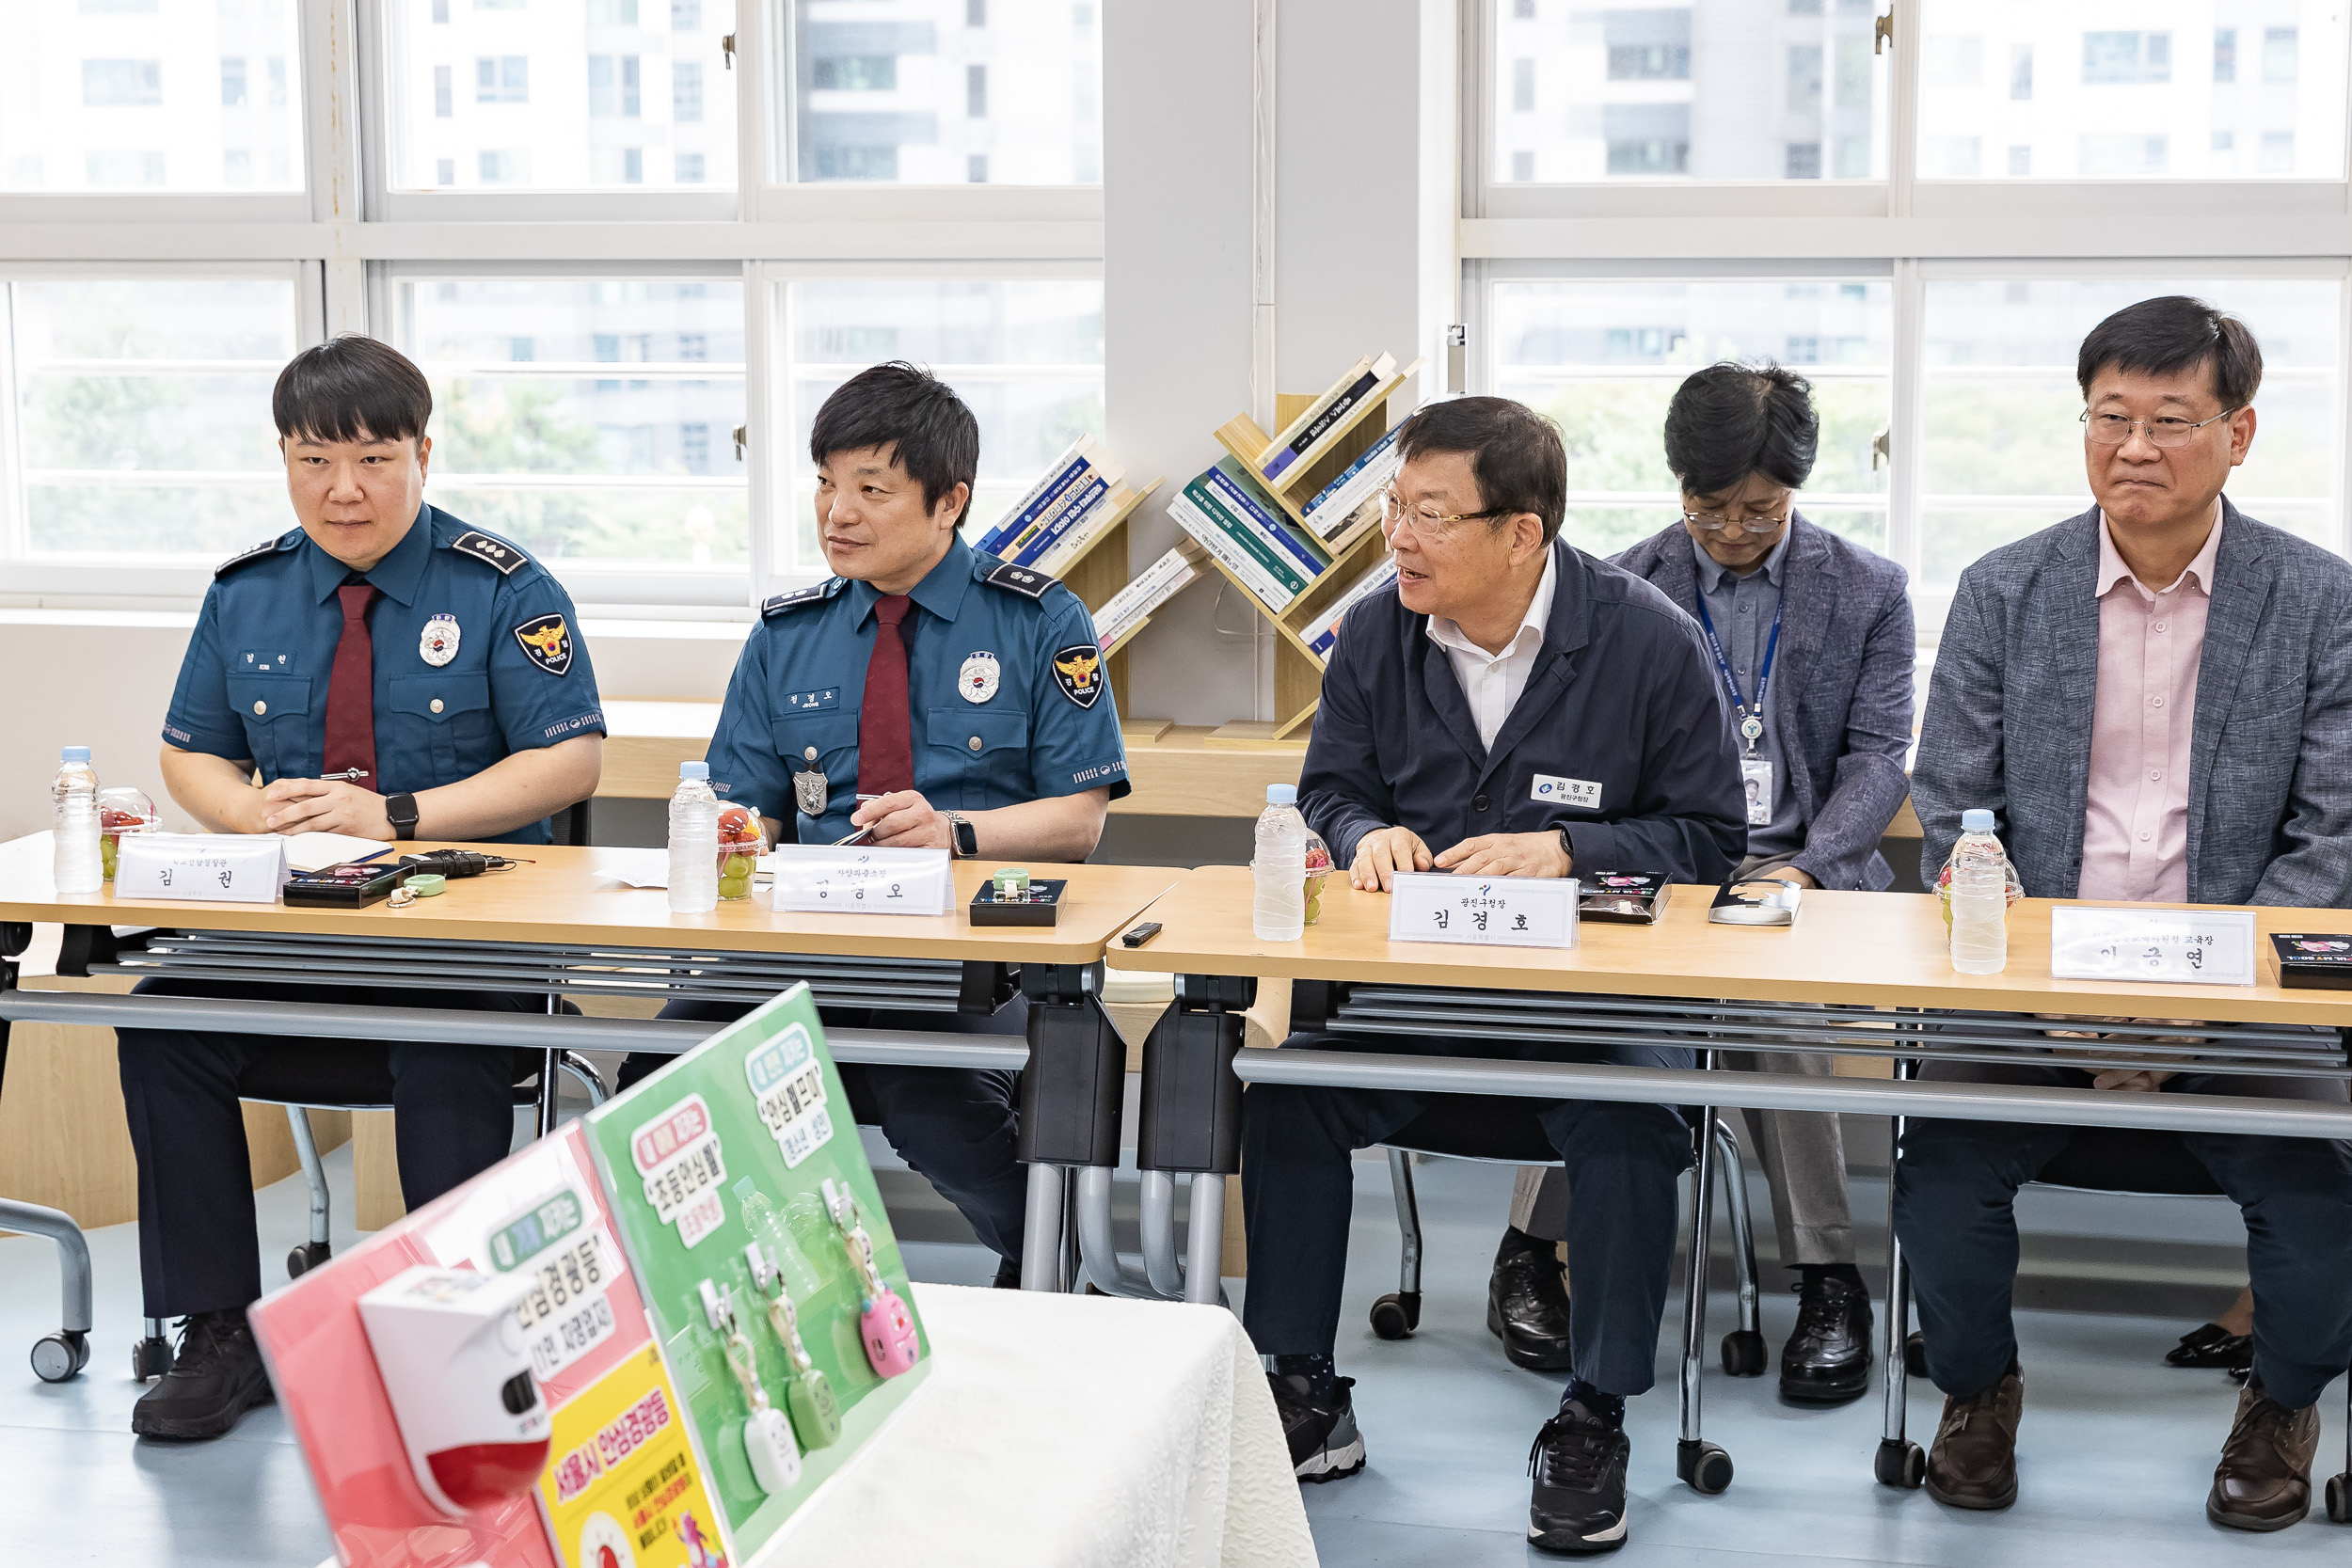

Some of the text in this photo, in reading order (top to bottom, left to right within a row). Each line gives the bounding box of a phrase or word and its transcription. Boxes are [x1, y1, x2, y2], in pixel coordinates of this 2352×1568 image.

[1049, 514, 1071, 535] 이야기
[546, 653, 567, 665] POLICE
[1065, 677, 1072, 687] 경
[1073, 688, 1095, 696] POLICE
[1557, 782, 1595, 795] 김 경 호
[1561, 794, 1588, 802] 광진구청장
[159, 868, 232, 889] 김 권
[886, 884, 903, 898] 오
[1461, 898, 1506, 910] 광진구청장
[1433, 909, 1529, 931] 김 경 호
[2184, 935, 2214, 945] 교육장
[2186, 948, 2202, 970] 연
[553, 1440, 601, 1503] 서울시
